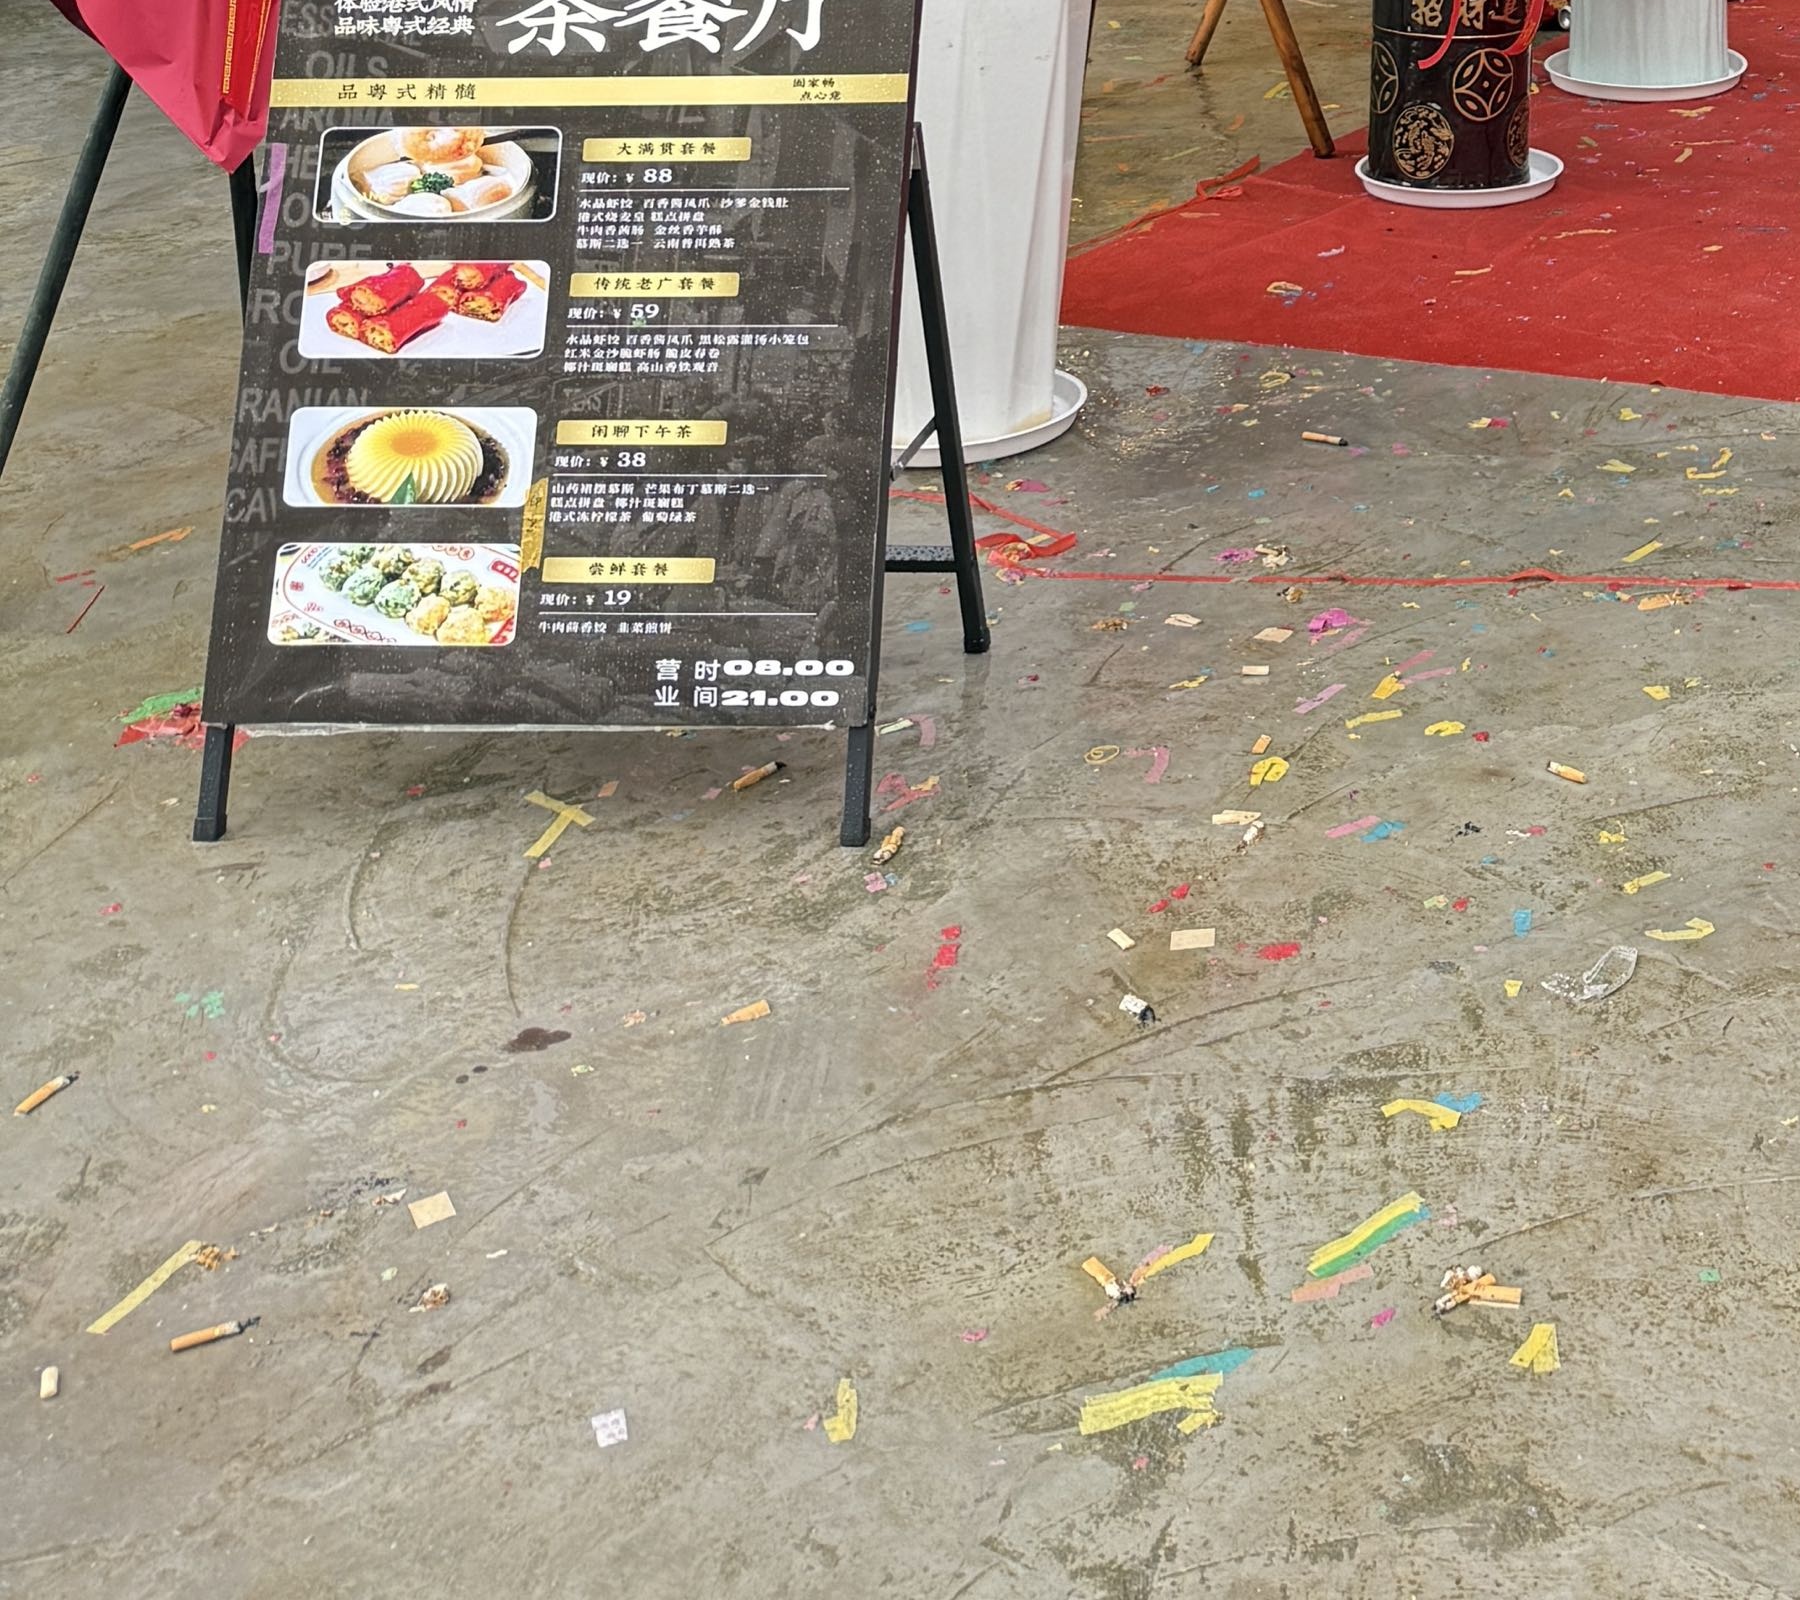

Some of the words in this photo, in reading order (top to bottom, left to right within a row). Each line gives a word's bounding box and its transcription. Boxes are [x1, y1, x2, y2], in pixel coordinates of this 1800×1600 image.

[333, 15, 476, 37] 品味粤式经典
[337, 83, 477, 101] 品粤式精髓
[616, 142, 718, 157] 大满贯套餐
[643, 168, 673, 184] 88
[593, 277, 717, 291] 传统老广套餐
[629, 303, 661, 319] 59
[591, 424, 694, 439] 闲聊下午茶
[616, 452, 648, 468] 38
[588, 561, 670, 578] 尝鲜套餐
[603, 588, 633, 606] 19
[654, 659, 683, 681] 营
[653, 685, 681, 708] 业
